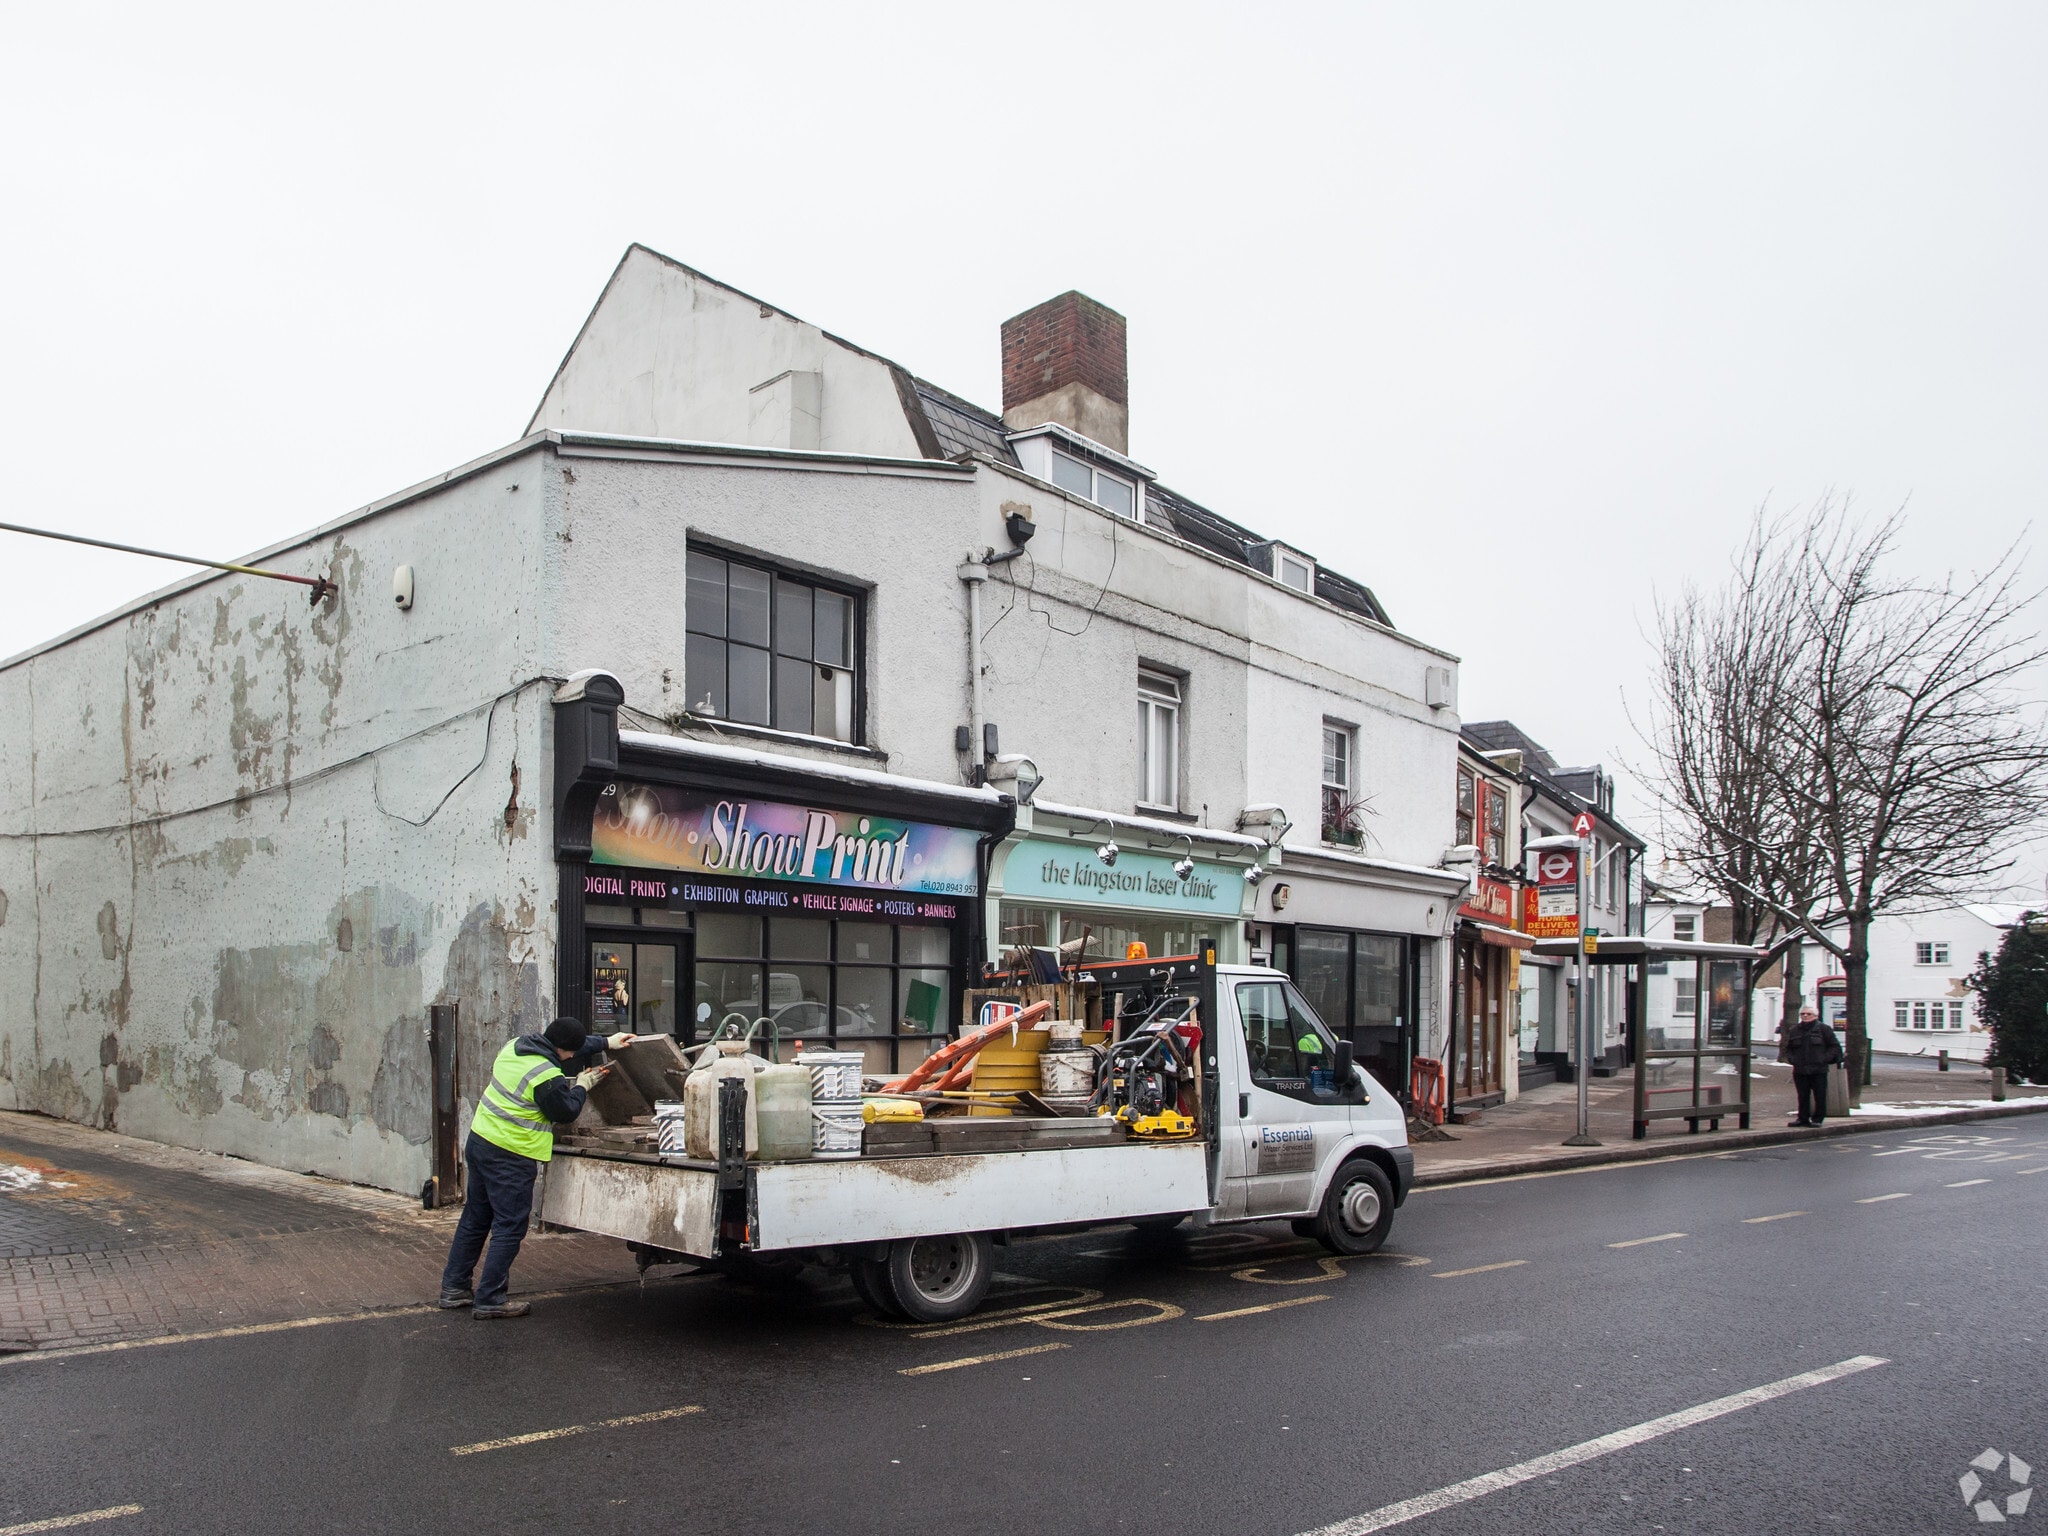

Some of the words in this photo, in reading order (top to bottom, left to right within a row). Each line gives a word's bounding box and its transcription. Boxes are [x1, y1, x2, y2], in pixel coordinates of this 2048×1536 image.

[1575, 815, 1591, 831] A
[1042, 859, 1070, 884] the
[1074, 862, 1143, 894] kingston
[1146, 870, 1178, 895] laser
[1182, 875, 1218, 900] clinic
[945, 883, 963, 893] 8943
[964, 885, 978, 894] 957
[585, 876, 625, 895] DIGITAL
[630, 880, 666, 898] PRINTS
[684, 884, 739, 904] EXHIBITION
[745, 889, 788, 907] GRAPHICS
[803, 893, 837, 910] VEHICLE
[839, 896, 874, 913] SIGNAGE
[884, 900, 915, 916] POSTERS
[924, 903, 956, 919] BANNERS
[1527, 921, 1577, 929] DELIVERY
[1560, 928, 1579, 936] 4895
[1275, 1082, 1306, 1090] TRANSIT
[1262, 1125, 1313, 1143] Essential
[1282, 1143, 1303, 1152] Services
